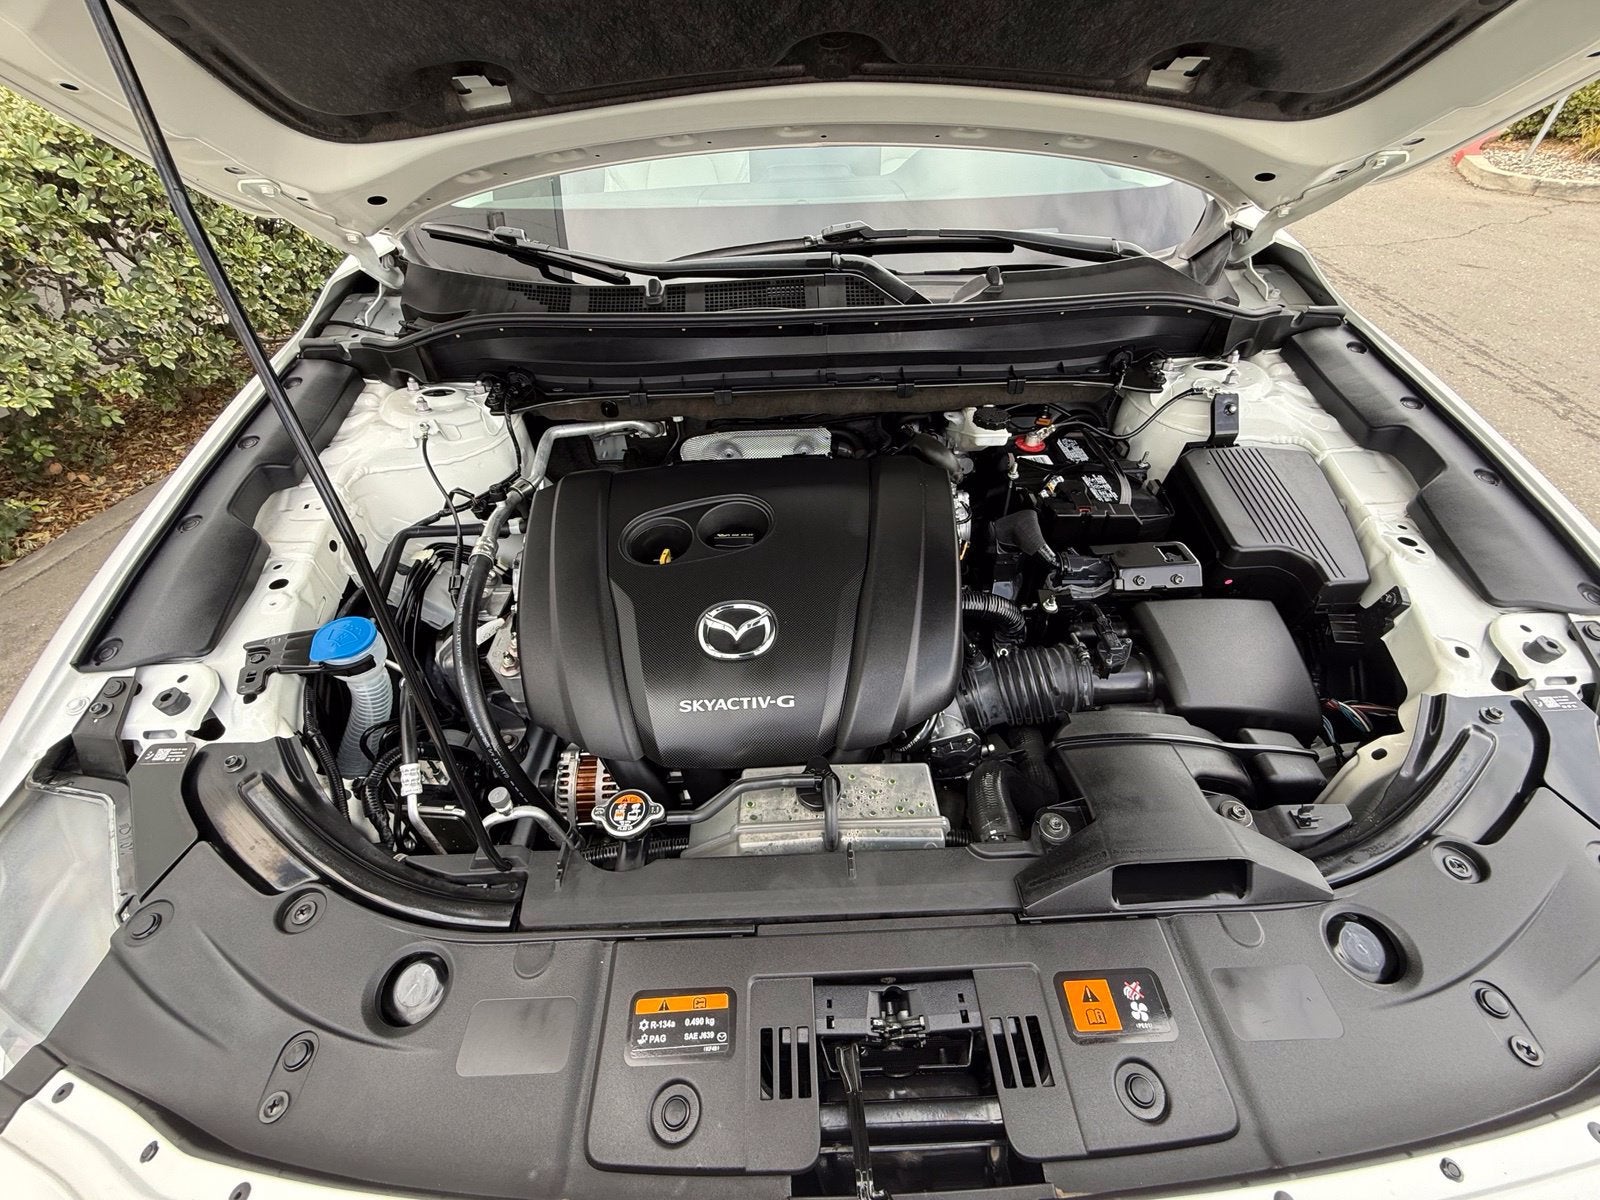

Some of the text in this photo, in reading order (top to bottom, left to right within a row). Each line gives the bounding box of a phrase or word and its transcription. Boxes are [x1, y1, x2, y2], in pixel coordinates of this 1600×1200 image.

[679, 695, 795, 712] SKYACTIV-G
[650, 1016, 716, 1029] R-134a 0.490 kg
[649, 1031, 715, 1043] PAG SAE J639
